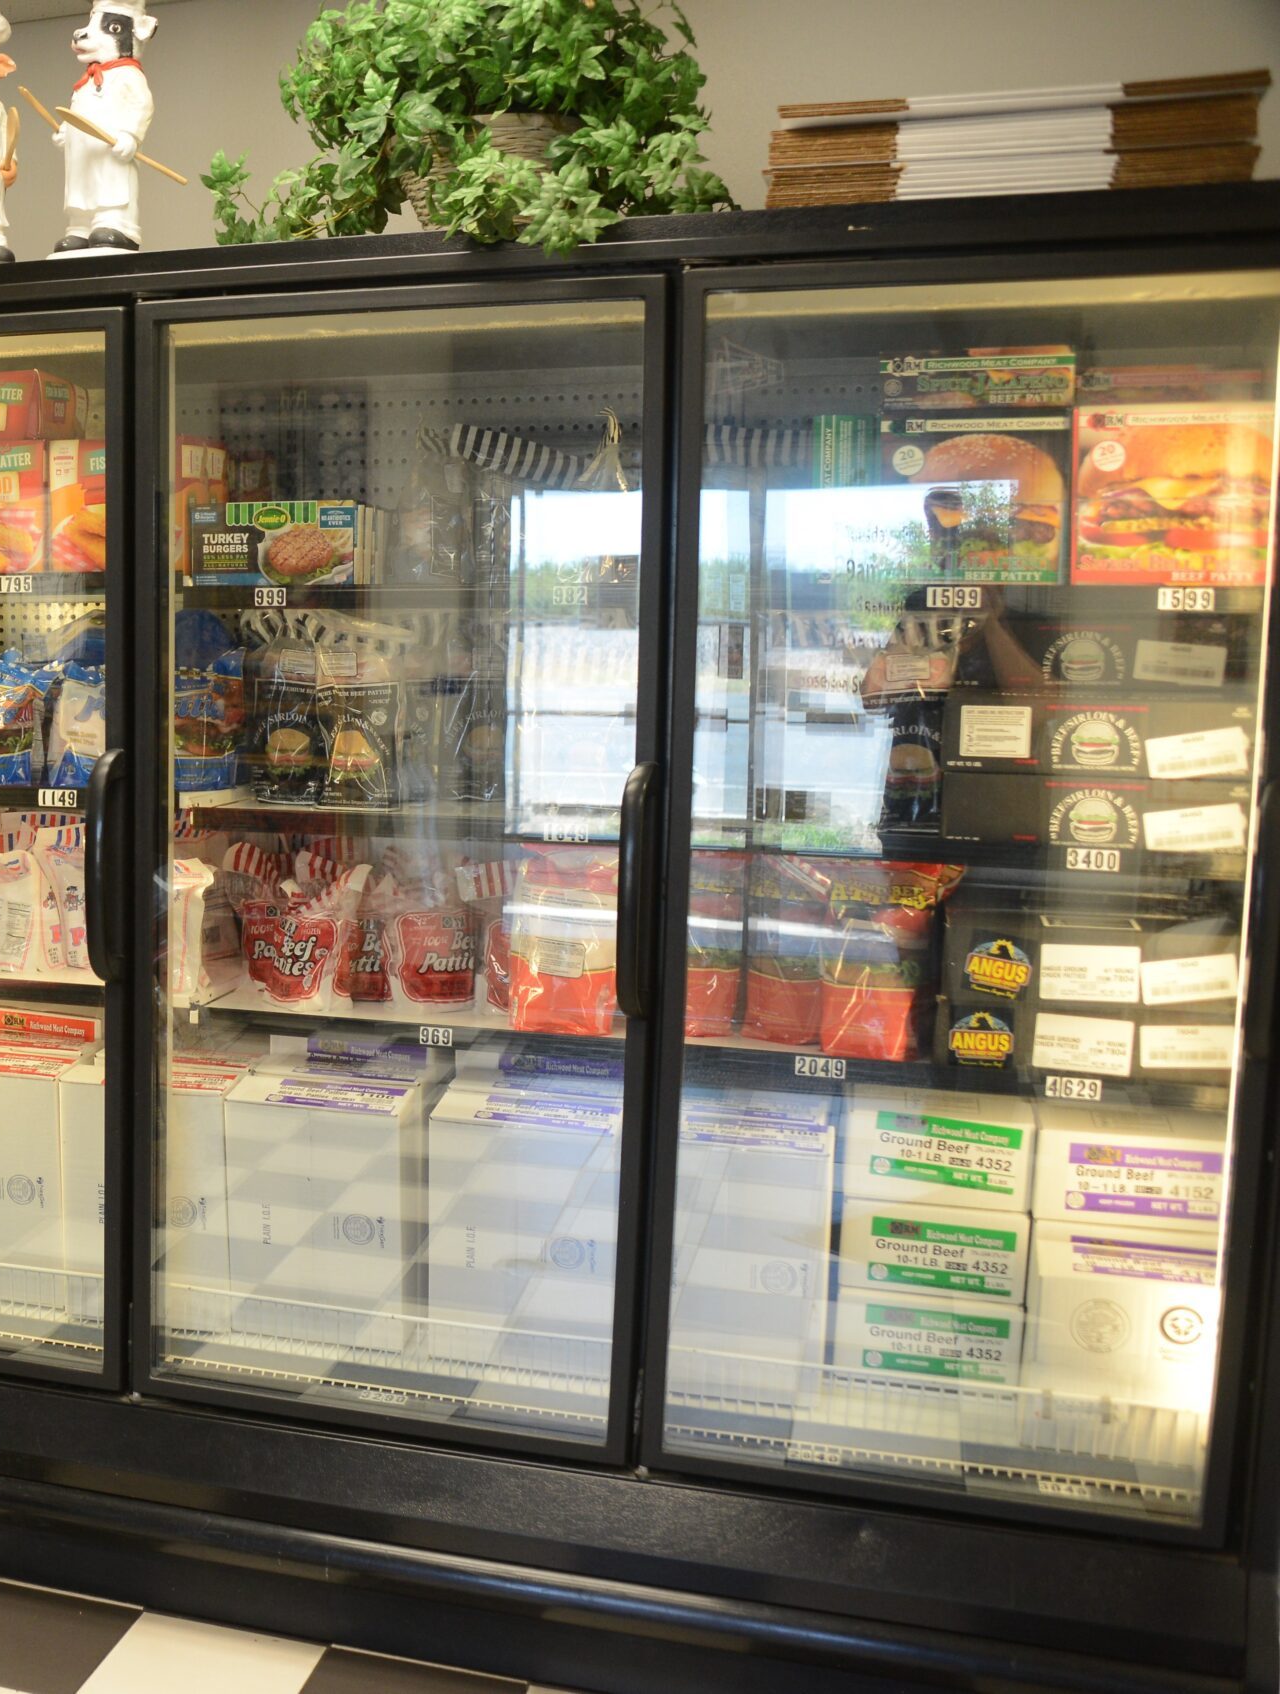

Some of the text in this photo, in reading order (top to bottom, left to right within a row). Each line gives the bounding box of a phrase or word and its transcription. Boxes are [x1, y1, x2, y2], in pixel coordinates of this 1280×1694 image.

[928, 360, 978, 369] RICHWOOD
[981, 359, 1008, 367] MEAT
[1009, 358, 1057, 366] COMPANY
[989, 392, 1065, 404] BEEF PATTY
[907, 419, 1065, 431] RM RICHWOOD MEAT COMPANY
[899, 449, 916, 460] 20
[1099, 445, 1116, 456] 20
[90, 456, 106, 471] FIS
[202, 533, 250, 544] TURKEY
[203, 545, 249, 554] BURGERS
[964, 571, 1042, 582] BEEF PATTY
[1172, 571, 1253, 582] BEEF PATTY
[256, 589, 285, 606] 999
[931, 588, 978, 607] 1599
[1161, 590, 1211, 609] 1599
[41, 790, 76, 806] 1149
[1069, 850, 1117, 869] 3400
[967, 956, 1028, 985] ANGUS
[30, 1020, 51, 1031] Richwood
[52, 1023, 63, 1033] Meat
[64, 1025, 85, 1037] Company
[421, 1027, 452, 1045] 969
[951, 1031, 1010, 1051] ANGUS
[797, 1058, 845, 1078] 2049
[1048, 1078, 1098, 1098] 4629
[880, 1131, 933, 1149] Ground
[937, 1140, 970, 1154] Beef
[900, 1149, 923, 1159] 10-1
[976, 1157, 1012, 1172] 4352
[1076, 1165, 1155, 1181] Ground Beef
[1170, 1185, 1215, 1199] 4152
[262, 1223, 271, 1245] PLAIN
[876, 1238, 965, 1258] Ground Beef
[466, 1246, 475, 1269] PLAIN
[896, 1254, 918, 1264] 10-1
[972, 1260, 1008, 1274] 4352
[870, 1326, 959, 1345] Ground Beef
[891, 1342, 913, 1352] 10-1
[966, 1347, 1002, 1361] 4352
